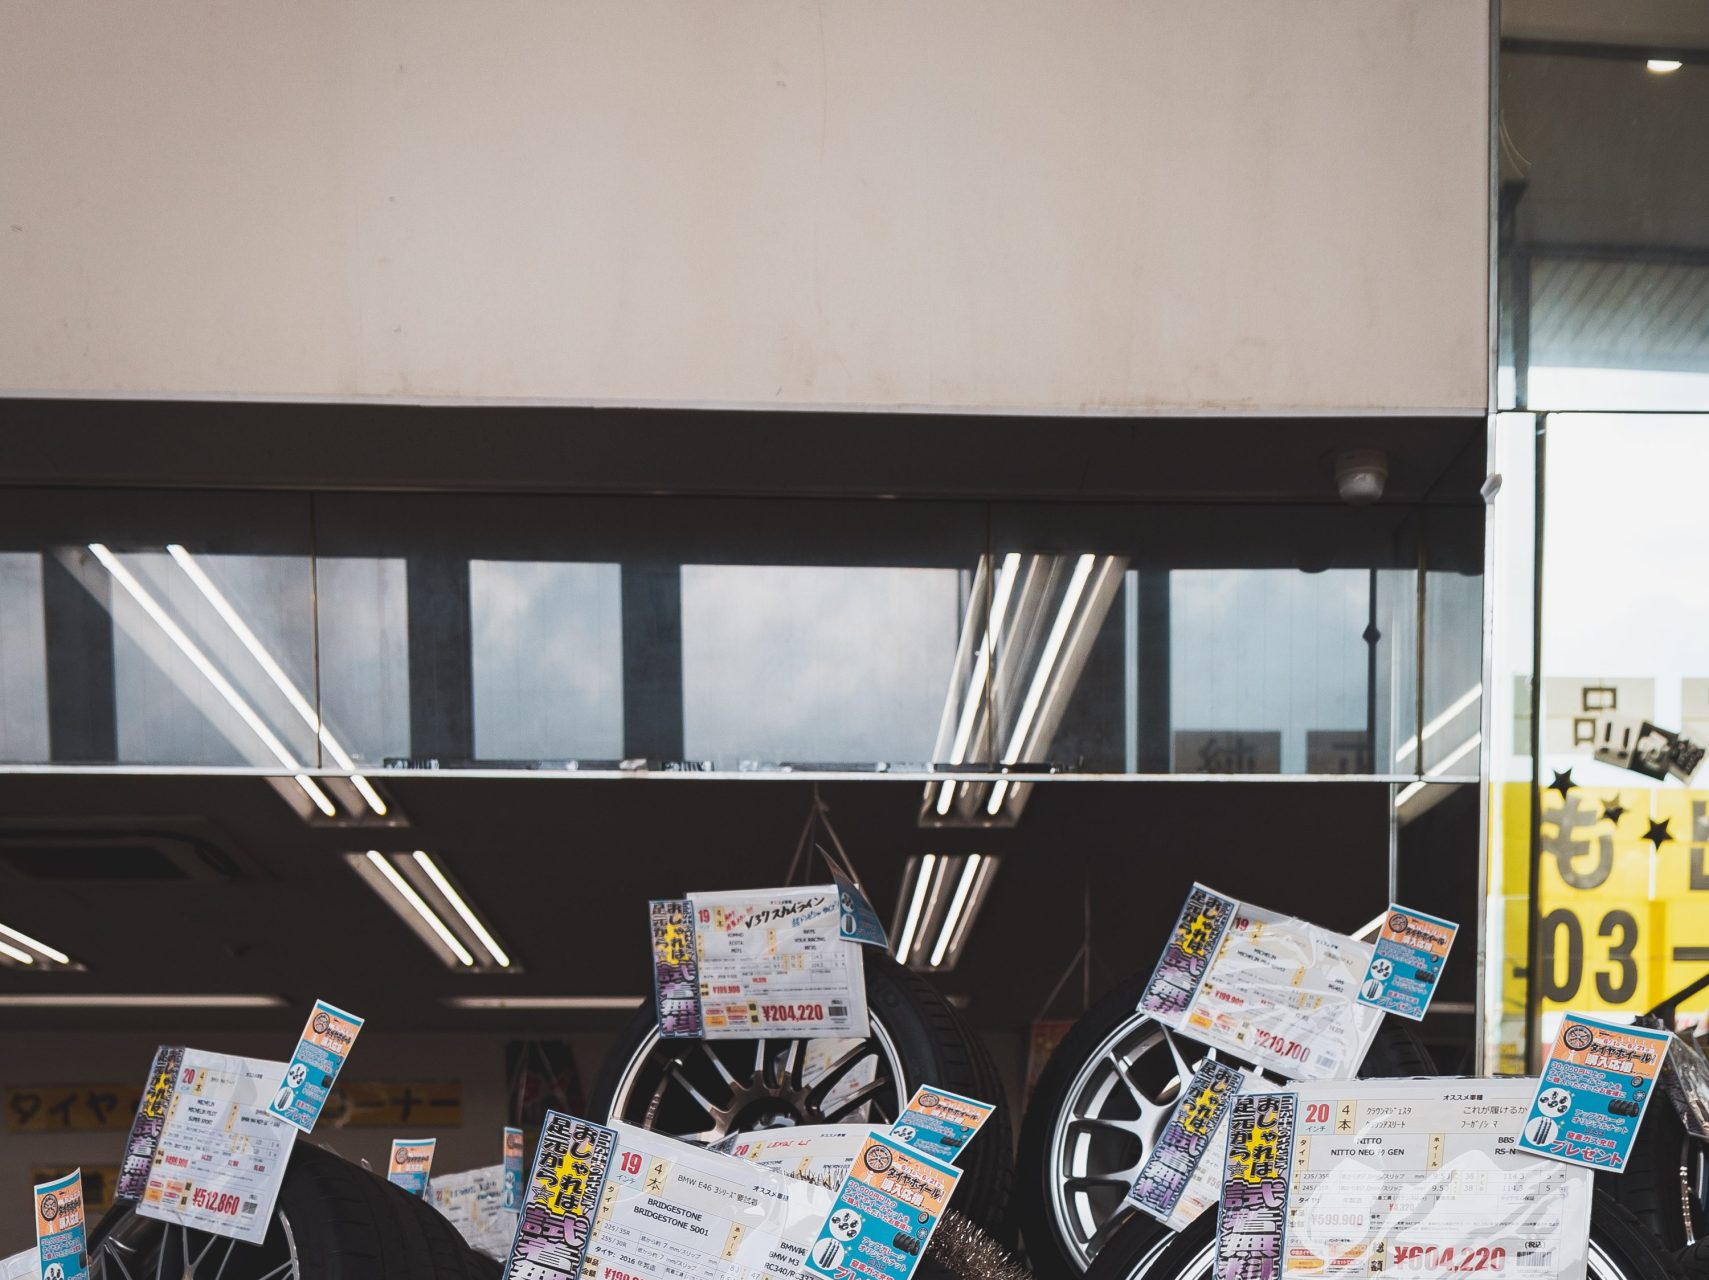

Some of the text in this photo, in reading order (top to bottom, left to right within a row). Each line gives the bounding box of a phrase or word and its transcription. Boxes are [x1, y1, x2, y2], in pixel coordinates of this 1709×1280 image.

[698, 909, 710, 922] 19
[773, 898, 824, 919] スカイライン
[1235, 917, 1249, 931] 19
[762, 1004, 823, 1022] ¥204,220
[1590, 1042, 1652, 1064] タイヤホイール
[183, 1068, 195, 1084] 20
[1189, 1067, 1229, 1129] おしゃれは
[1305, 1103, 1330, 1123] 20
[1463, 1106, 1527, 1114] これが履けるか
[1575, 1109, 1626, 1125] アップガレージ
[1229, 1097, 1254, 1161] 足元から
[1251, 1096, 1280, 1177] おしゃれは
[1461, 1121, 1498, 1129] フーガ/シマ
[535, 1116, 571, 1187] 足元から
[733, 1145, 749, 1156] 20
[1298, 1139, 1307, 1166] タイヤ
[1550, 1140, 1623, 1166] プレゼント
[556, 1124, 598, 1211] おしゃれは
[616, 1149, 644, 1176] 19
[676, 1173, 713, 1192] BMW E46
[887, 1168, 942, 1200] タイヤホイール
[193, 1187, 240, 1216] ¥512,860
[600, 1184, 616, 1213] タイヤ
[646, 1198, 703, 1222] BRIDGESTONE
[632, 1206, 709, 1237] BRIDGESTONE S001
[661, 1241, 669, 1249] 7
[862, 1237, 906, 1262] アップガレージ
[618, 1254, 636, 1265] 2016
[768, 1250, 800, 1266] BMW M3
[1394, 1246, 1506, 1272] ¥604,220
